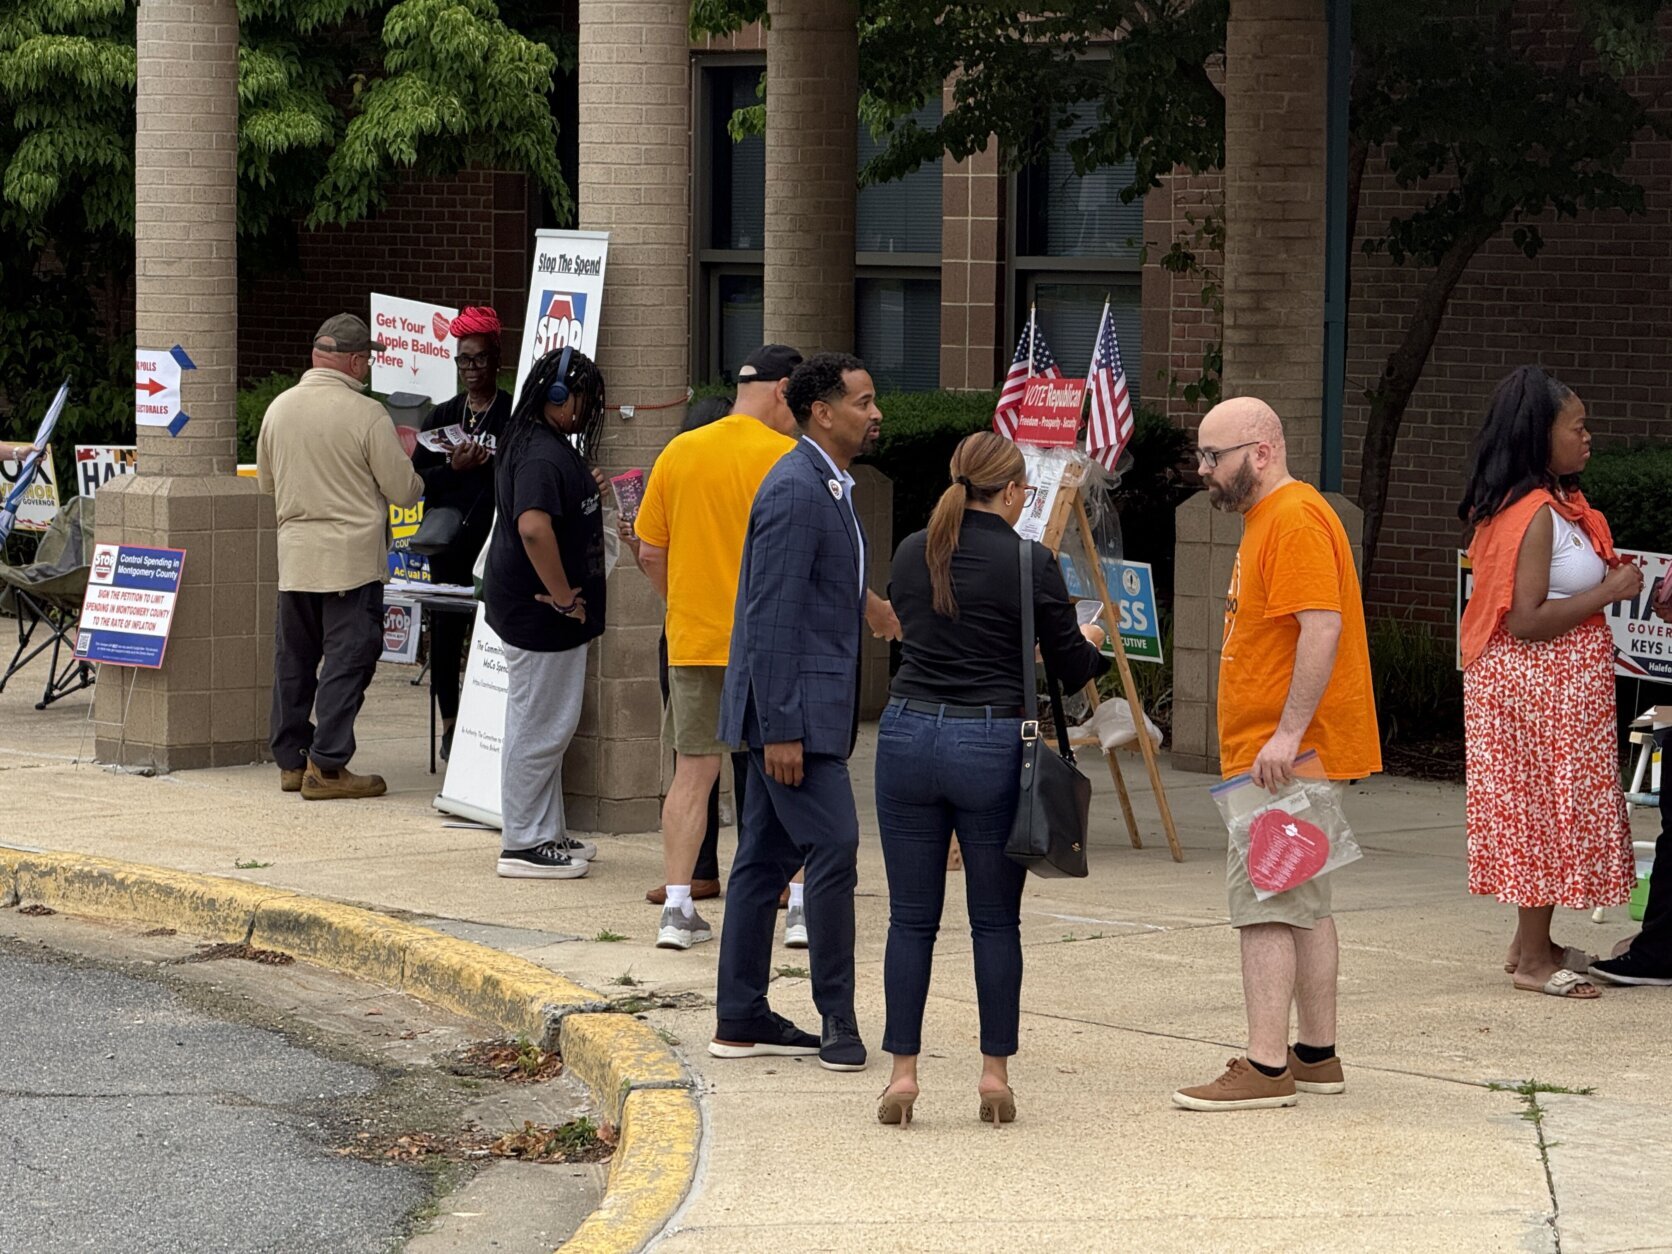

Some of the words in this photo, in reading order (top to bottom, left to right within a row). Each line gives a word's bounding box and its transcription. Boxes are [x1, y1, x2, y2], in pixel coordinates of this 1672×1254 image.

[538, 253, 557, 274] Stop
[559, 254, 573, 273] The
[574, 255, 602, 276] Spend
[376, 313, 397, 329] Get
[399, 317, 426, 334] Your
[376, 331, 409, 351] Apple
[411, 338, 450, 359] Ballots
[533, 314, 583, 360] STOP
[376, 351, 404, 368] Here
[1023, 384, 1049, 407] VOTE
[1045, 383, 1082, 413] Republican
[1019, 415, 1039, 427] Freedom
[22, 499, 56, 507] GOVERNOR
[95, 554, 116, 566] STOP
[120, 553, 143, 565] Control
[143, 555, 172, 569] Spending
[172, 559, 180, 567] in
[117, 565, 155, 579] Montgomery
[155, 569, 178, 581] County
[97, 589, 110, 599] SIGN
[110, 590, 120, 600] THE
[120, 591, 143, 602] PETITION
[143, 593, 150, 603] TO
[150, 594, 165, 604] LIMIT
[85, 601, 109, 613] SPENDING
[109, 604, 116, 614] IN
[116, 605, 150, 617] MONTGOMERY
[149, 608, 170, 618] COUNTY
[93, 616, 99, 626] TO
[100, 617, 111, 627] THE
[110, 618, 125, 629] RATE
[124, 620, 132, 629] OF
[131, 620, 157, 632] INFLATION
[1627, 622, 1672, 638] GOVER
[1630, 639, 1663, 655] KEYS
[482, 658, 496, 671] MoCo
